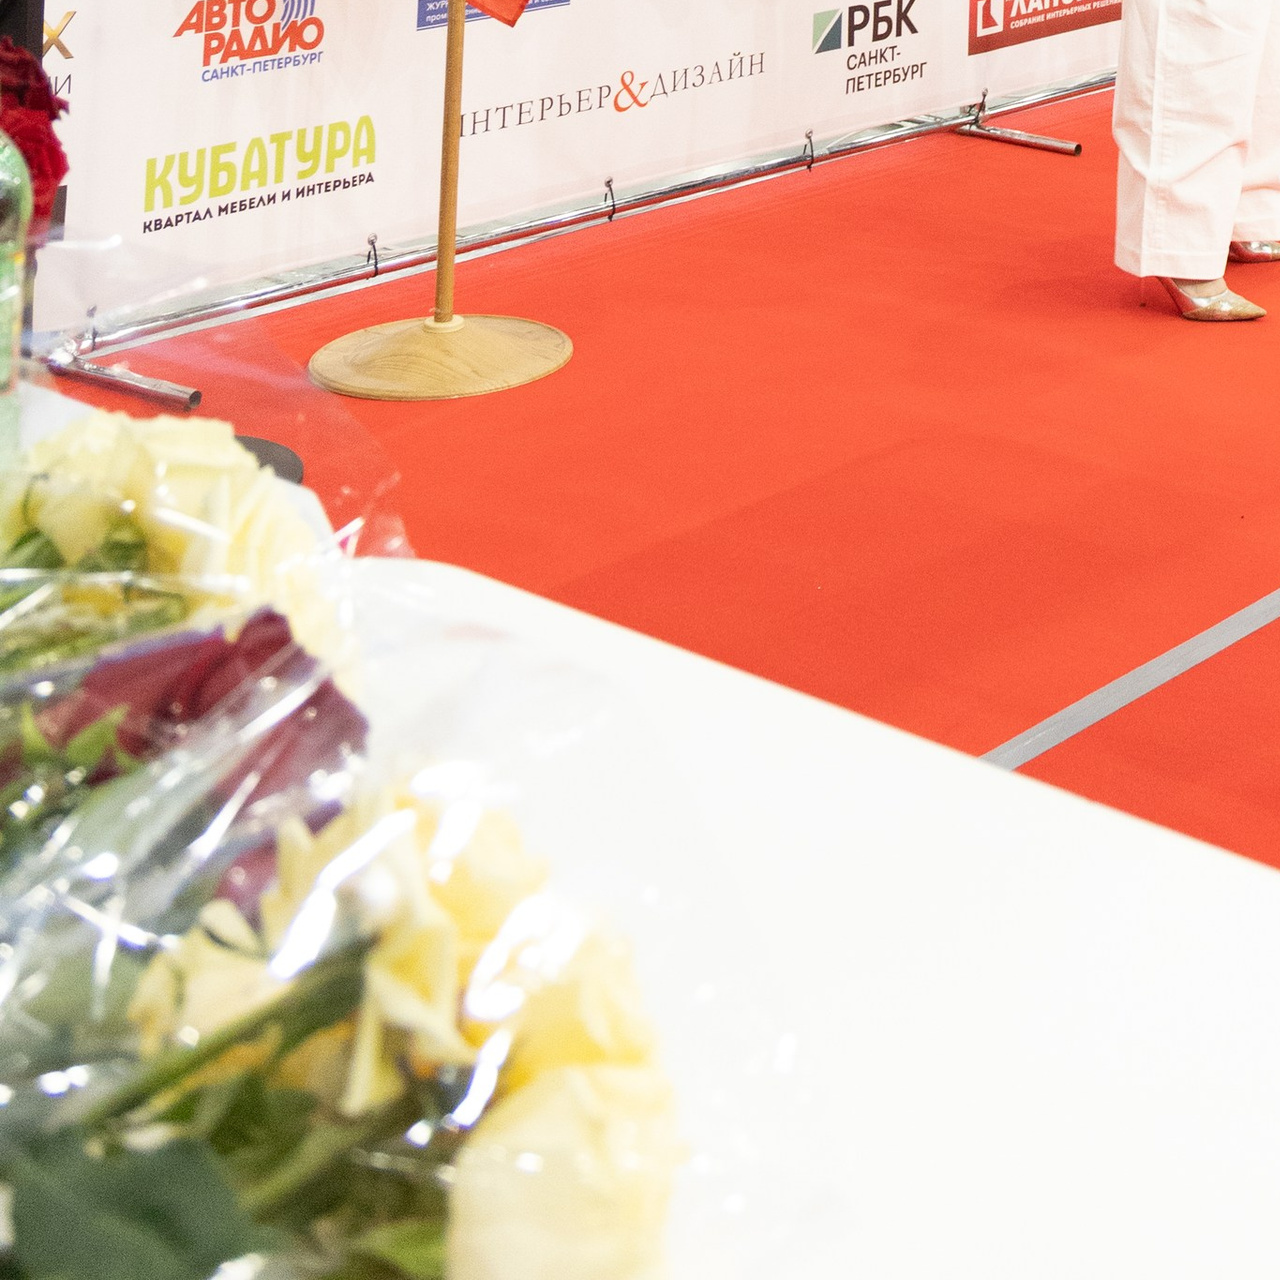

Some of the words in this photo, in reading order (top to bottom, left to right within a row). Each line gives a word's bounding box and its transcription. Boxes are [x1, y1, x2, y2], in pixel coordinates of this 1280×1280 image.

[1010, 14, 1045, 29] СОБРАНИЕ
[1046, 5, 1091, 20] ИНТЕРЬЕРНЫХ
[202, 16, 324, 67] РАДИО
[846, 45, 901, 71] САНКТ-
[202, 51, 324, 82] САНКТ-ПЕТЕРБУРГ
[845, 62, 927, 95] ПЕТЕРБУРГ
[144, 114, 376, 212] КУБАТУРА
[143, 207, 213, 234] КВАРТАЛ
[217, 192, 276, 217] МЕБЕЛИ
[281, 189, 291, 202] И
[296, 171, 375, 199] ИНТЕРЬЕРА
